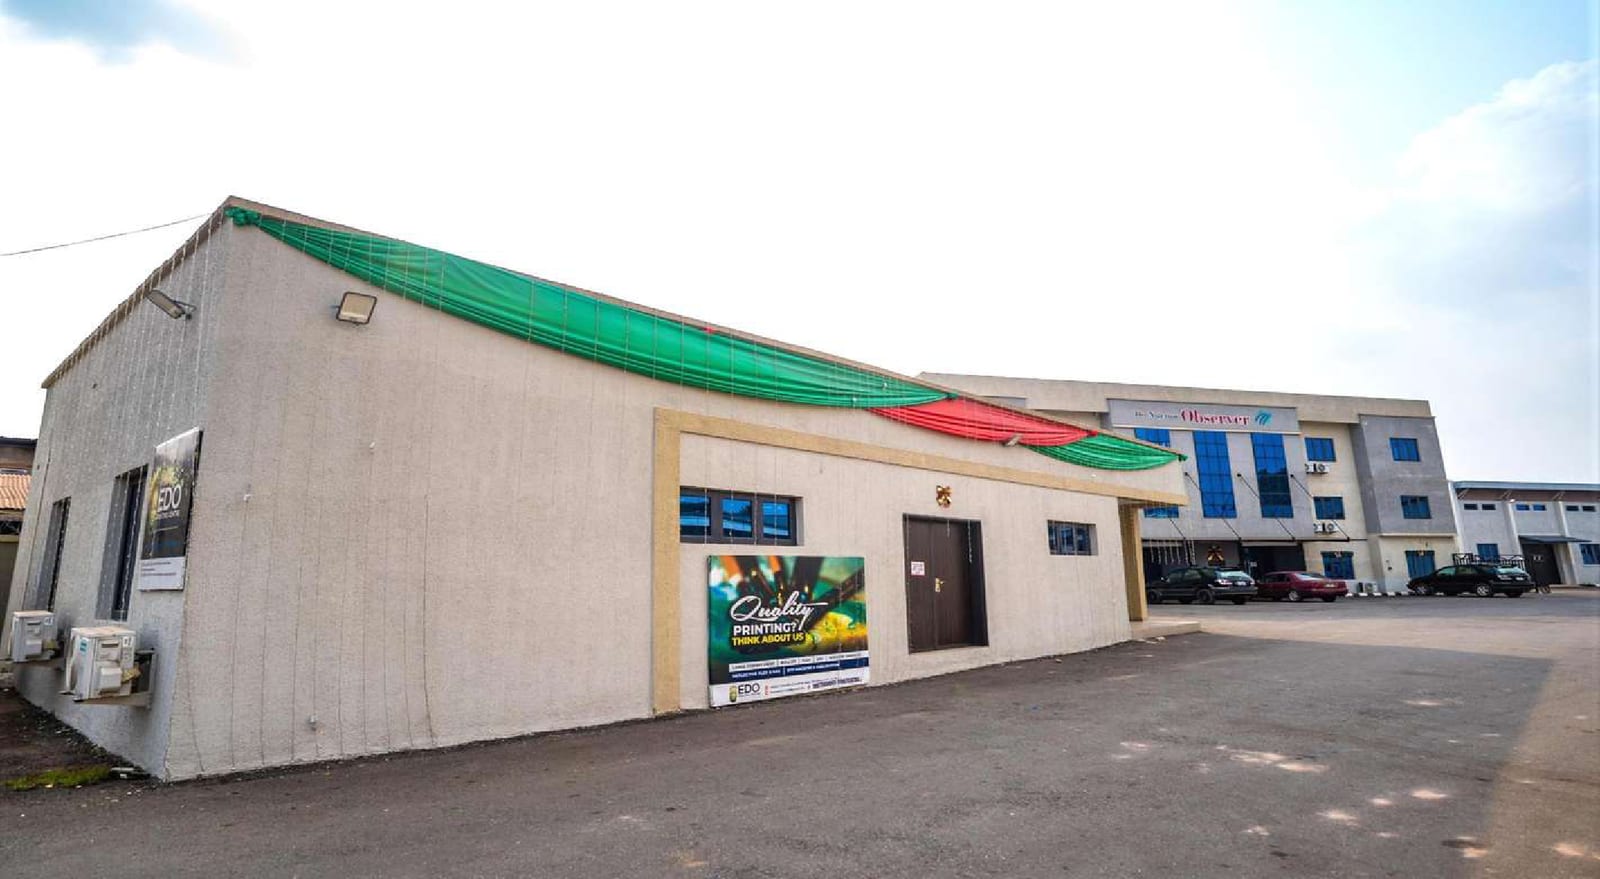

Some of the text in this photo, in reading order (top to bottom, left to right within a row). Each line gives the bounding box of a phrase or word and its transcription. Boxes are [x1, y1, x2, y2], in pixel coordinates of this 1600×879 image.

[1181, 409, 1249, 425] Observer
[158, 484, 181, 512] EDO
[730, 590, 828, 631] Quality
[733, 623, 797, 636] PRINTING?
[731, 636, 761, 647] THINK
[761, 633, 791, 643] ABOUT
[738, 682, 760, 694] EDO
